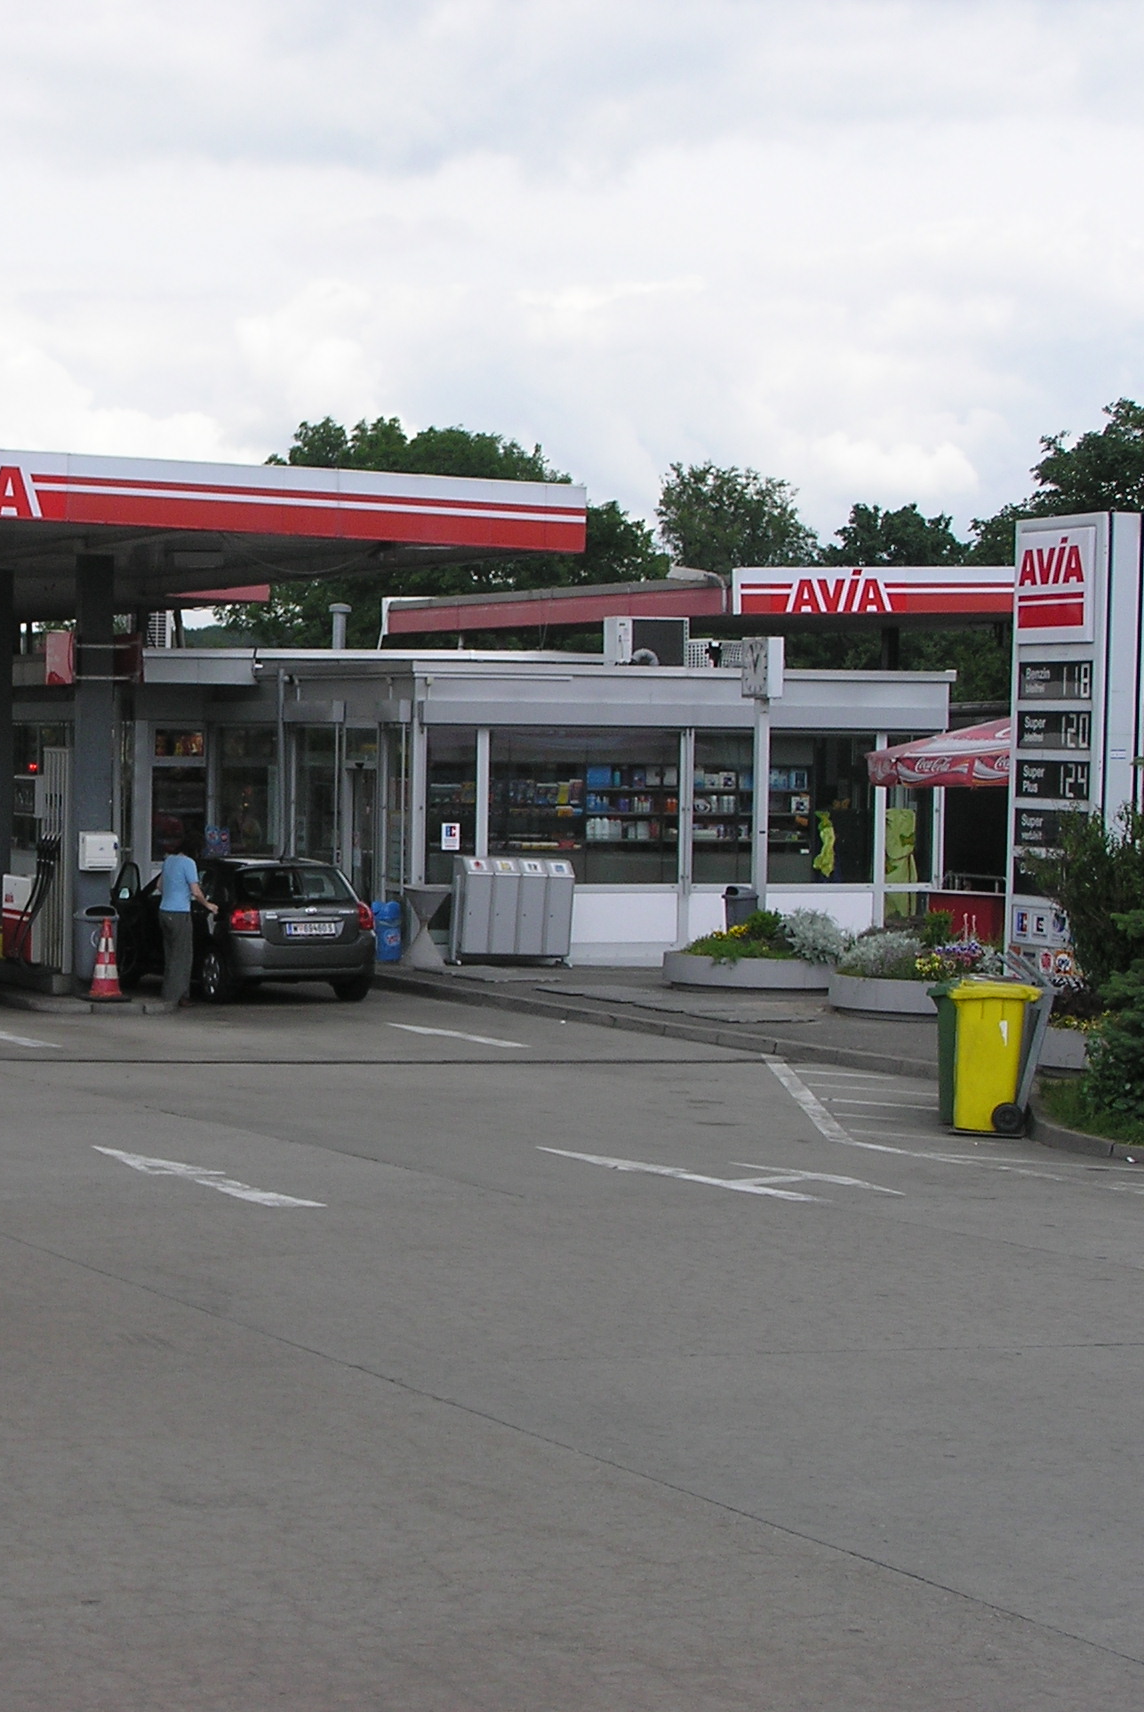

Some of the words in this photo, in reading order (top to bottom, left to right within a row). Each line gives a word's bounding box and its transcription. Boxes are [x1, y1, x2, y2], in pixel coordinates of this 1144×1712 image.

[1019, 537, 1084, 587] AVIA
[792, 569, 887, 613] AVIA
[1025, 667, 1051, 680] Benzin
[1024, 716, 1046, 731] Super
[1061, 713, 1089, 748] 120
[1023, 764, 1045, 779] Super
[1023, 780, 1038, 793] Plus
[1060, 763, 1087, 798] 124
[1021, 813, 1044, 828] Super
